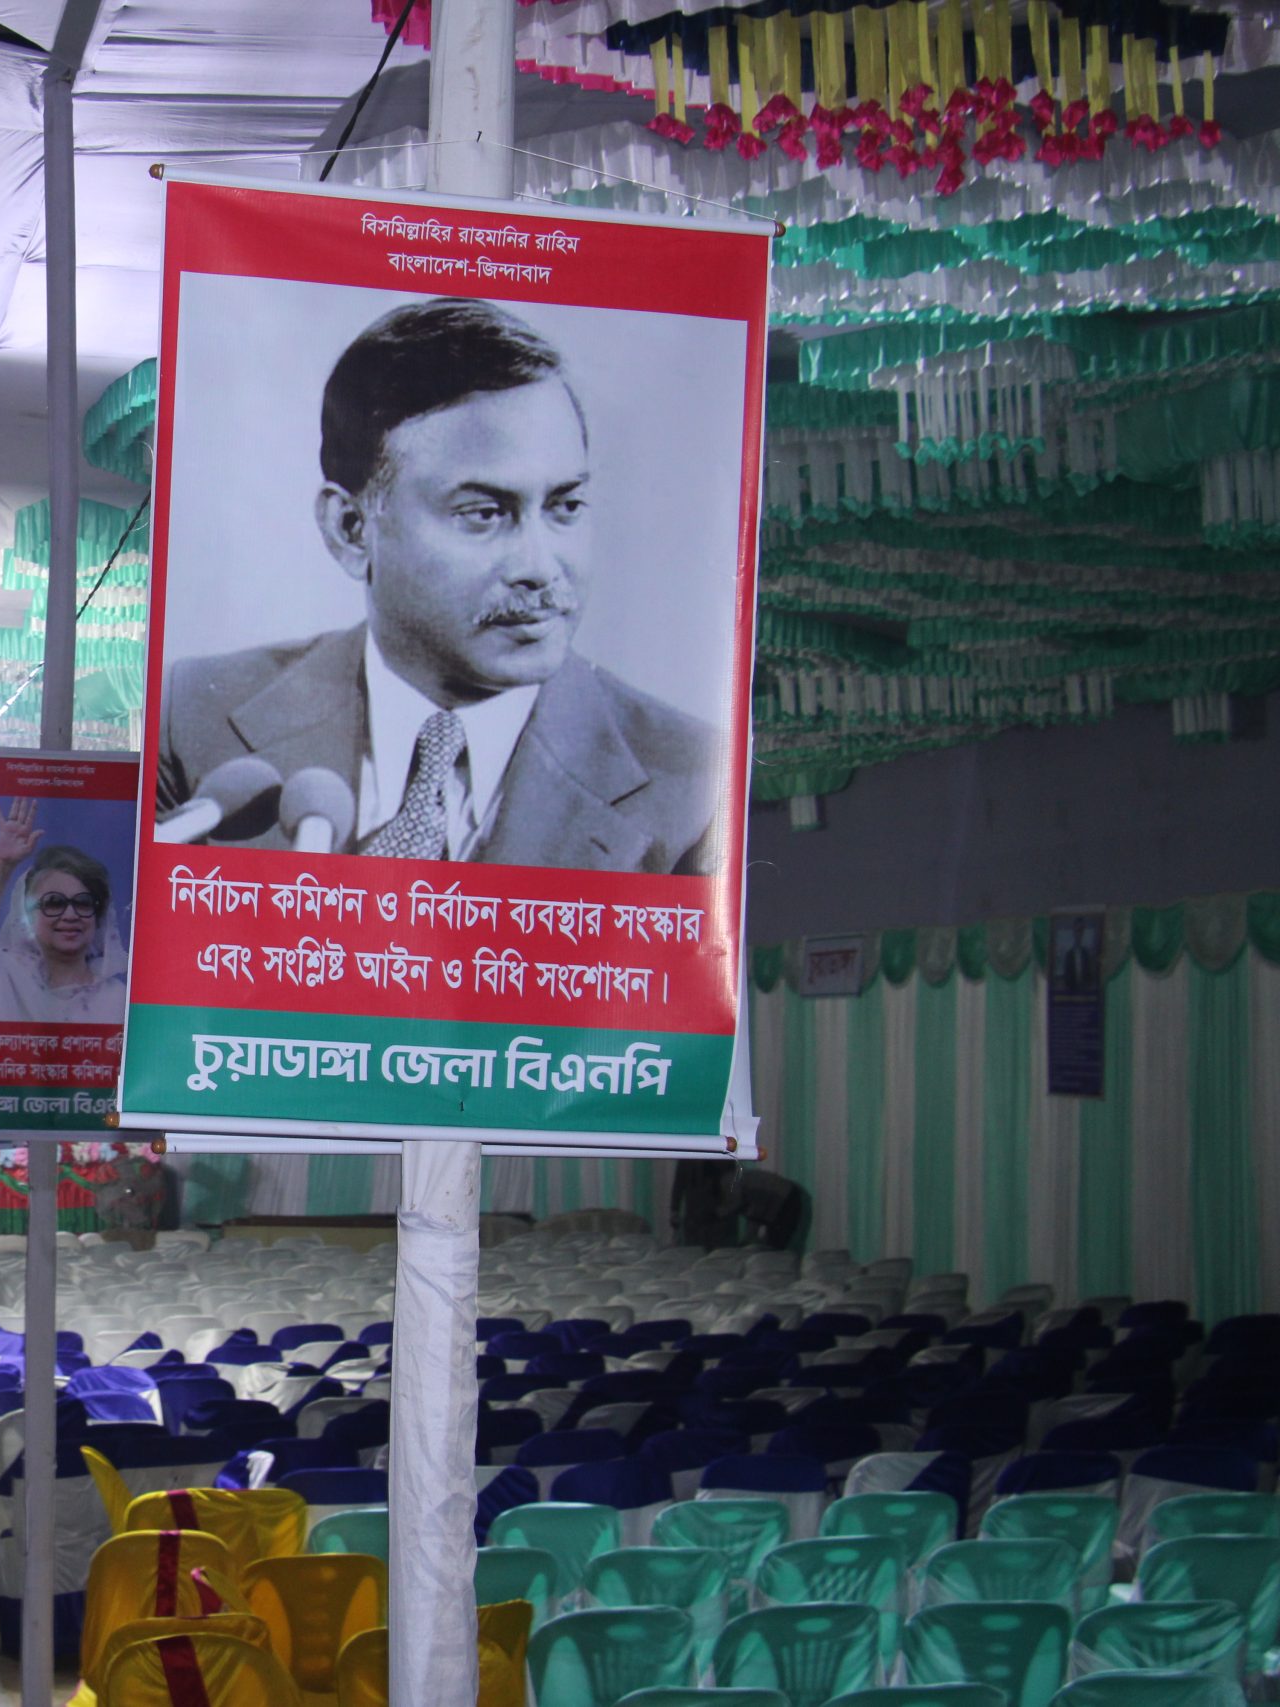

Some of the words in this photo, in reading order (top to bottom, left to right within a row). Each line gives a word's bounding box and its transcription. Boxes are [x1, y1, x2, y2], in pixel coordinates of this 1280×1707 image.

[361, 213, 453, 242] বিসমিল্লাহির
[458, 226, 530, 249] রাহমানির
[535, 230, 580, 254] রাহিম
[168, 864, 263, 918] নির্বাচন
[269, 872, 368, 924] কমিশন
[376, 892, 398, 922] ও
[407, 880, 502, 932] নির্বাচন
[508, 898, 606, 945] ব্যবস্থার
[612, 903, 705, 943] সংস্কার
[197, 943, 255, 984] এবং
[261, 935, 347, 988] সংশ্লিষ্ট
[354, 941, 434, 994] আইন
[441, 959, 463, 989] ও
[472, 946, 529, 997] বিধি
[30, 1063, 68, 1080] সংস্কার
[72, 1059, 113, 1080] কমিশন
[187, 1034, 371, 1091] চুয়াডাঙ্গা
[382, 1045, 497, 1088] জেলা
[505, 1036, 672, 1096] বিএনপি
[23, 1096, 69, 1114] জেলা
